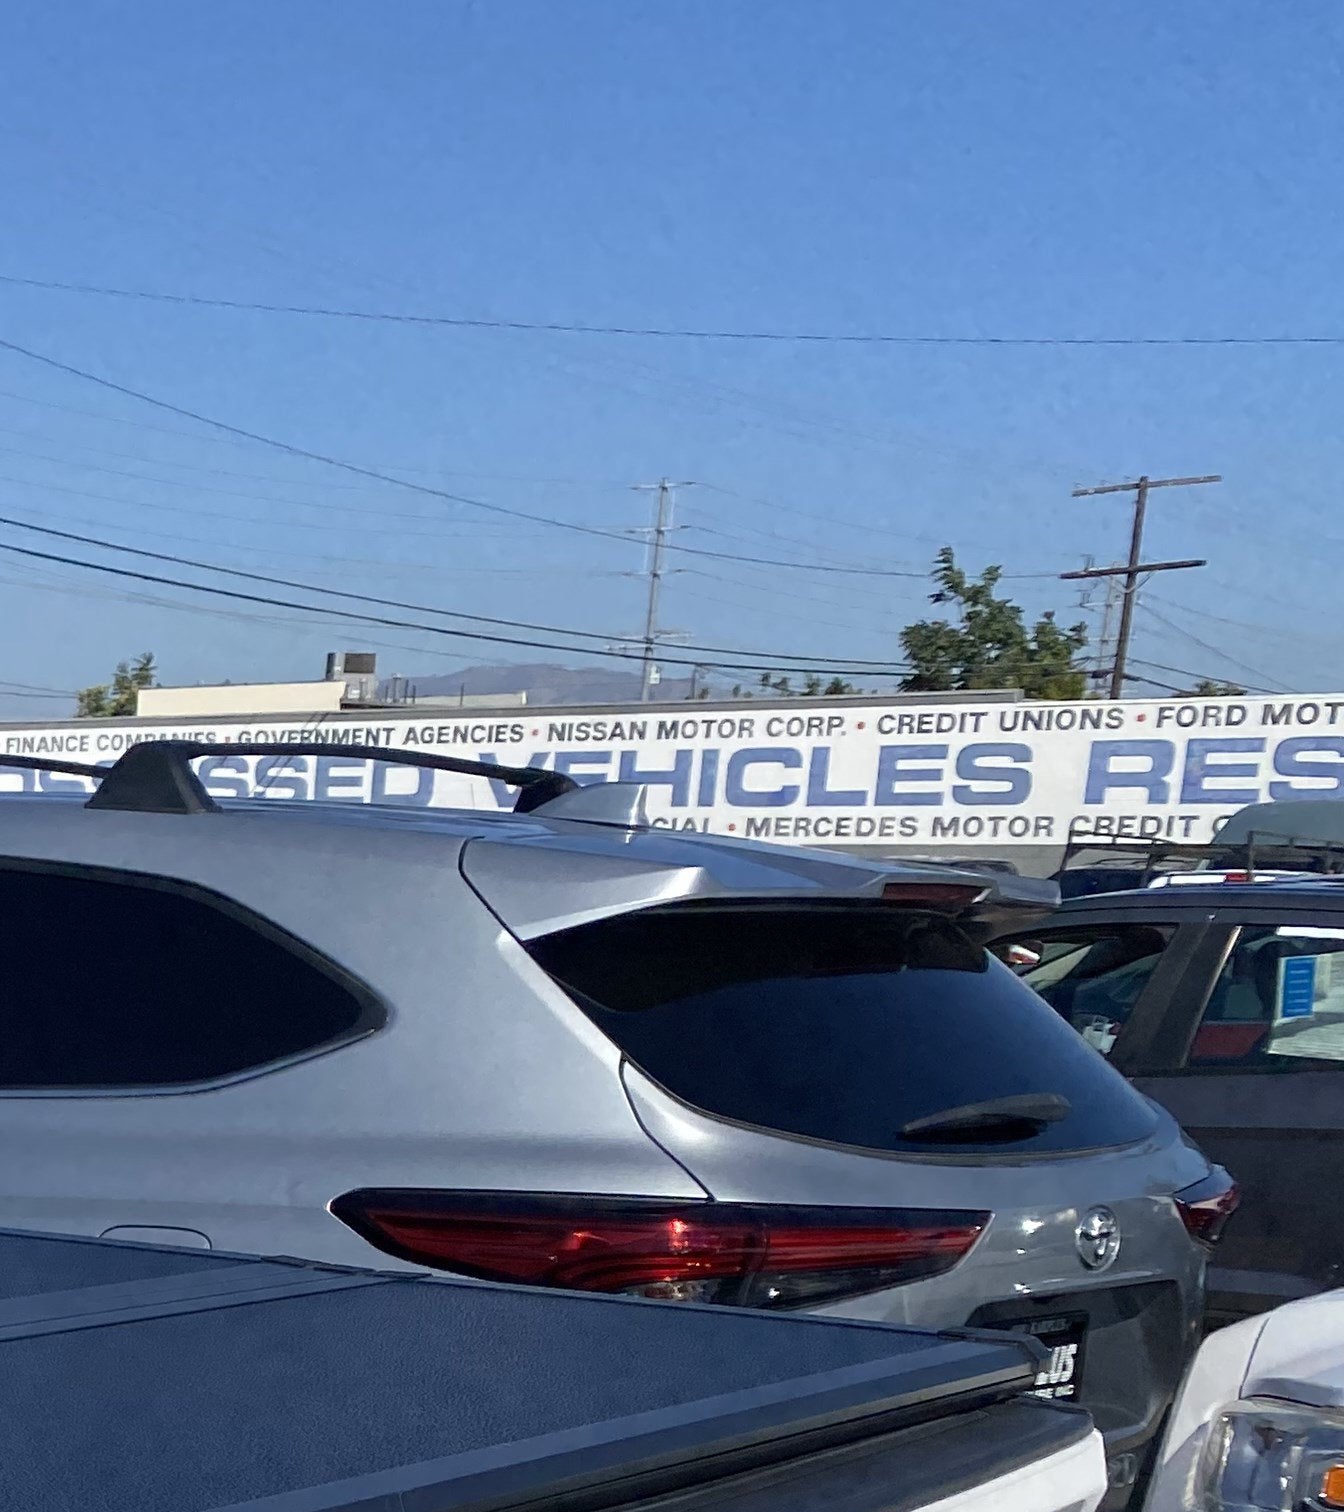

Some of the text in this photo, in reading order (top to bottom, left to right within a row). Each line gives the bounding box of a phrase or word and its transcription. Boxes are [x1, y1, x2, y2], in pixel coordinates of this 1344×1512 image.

[5, 735, 90, 754] FINANCE
[237, 727, 395, 746] GOVERNMENT
[402, 724, 524, 745] AGENCIES
[547, 721, 648, 742] NISSAN
[656, 718, 756, 740] MOTOR
[765, 715, 848, 738] CORP.
[876, 711, 990, 735] CREDIT
[999, 707, 1125, 732] UNIONS
[1155, 704, 1248, 729] FORD
[478, 742, 1034, 807] VEHICLES
[745, 816, 919, 838] MERCEDES
[931, 815, 1054, 838] MOTOR
[1070, 814, 1201, 839] CREDIT
